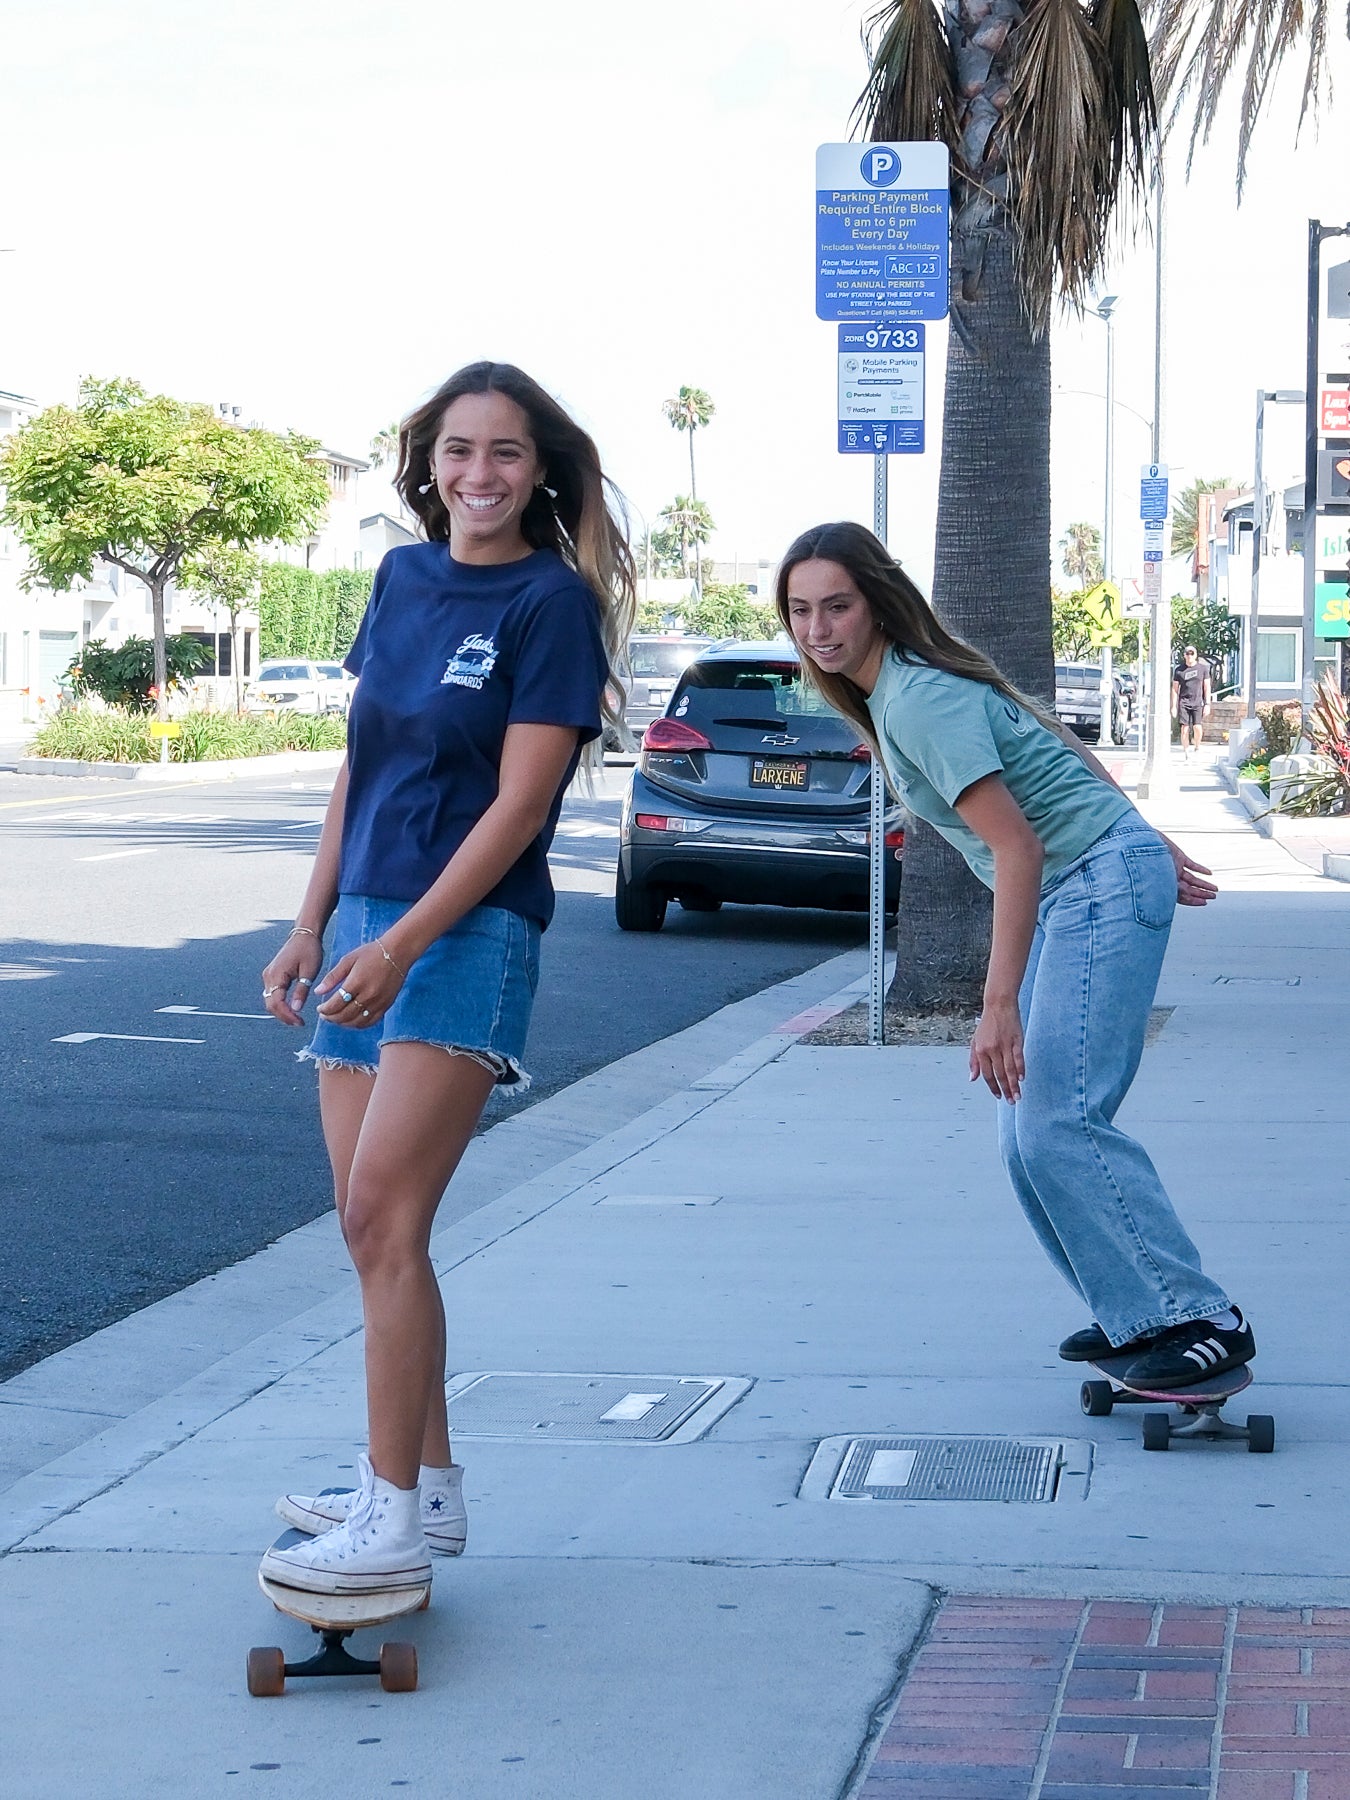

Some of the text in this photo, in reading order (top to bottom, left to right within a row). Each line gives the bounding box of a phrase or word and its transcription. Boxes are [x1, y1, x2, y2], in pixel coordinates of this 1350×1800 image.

[871, 154, 893, 181] P
[832, 192, 928, 204] Parking Payment
[818, 204, 942, 216] Required Entire Block
[844, 217, 916, 228] 8 am to 6 pm
[852, 229, 909, 240] Every Day
[906, 243, 940, 252] Holidays
[869, 268, 881, 276] Pay
[890, 264, 936, 274] ABC 123
[865, 330, 919, 348] 9733
[890, 359, 918, 367] Parking
[1324, 410, 1347, 429] Spa
[752, 768, 805, 785] LARXENE
